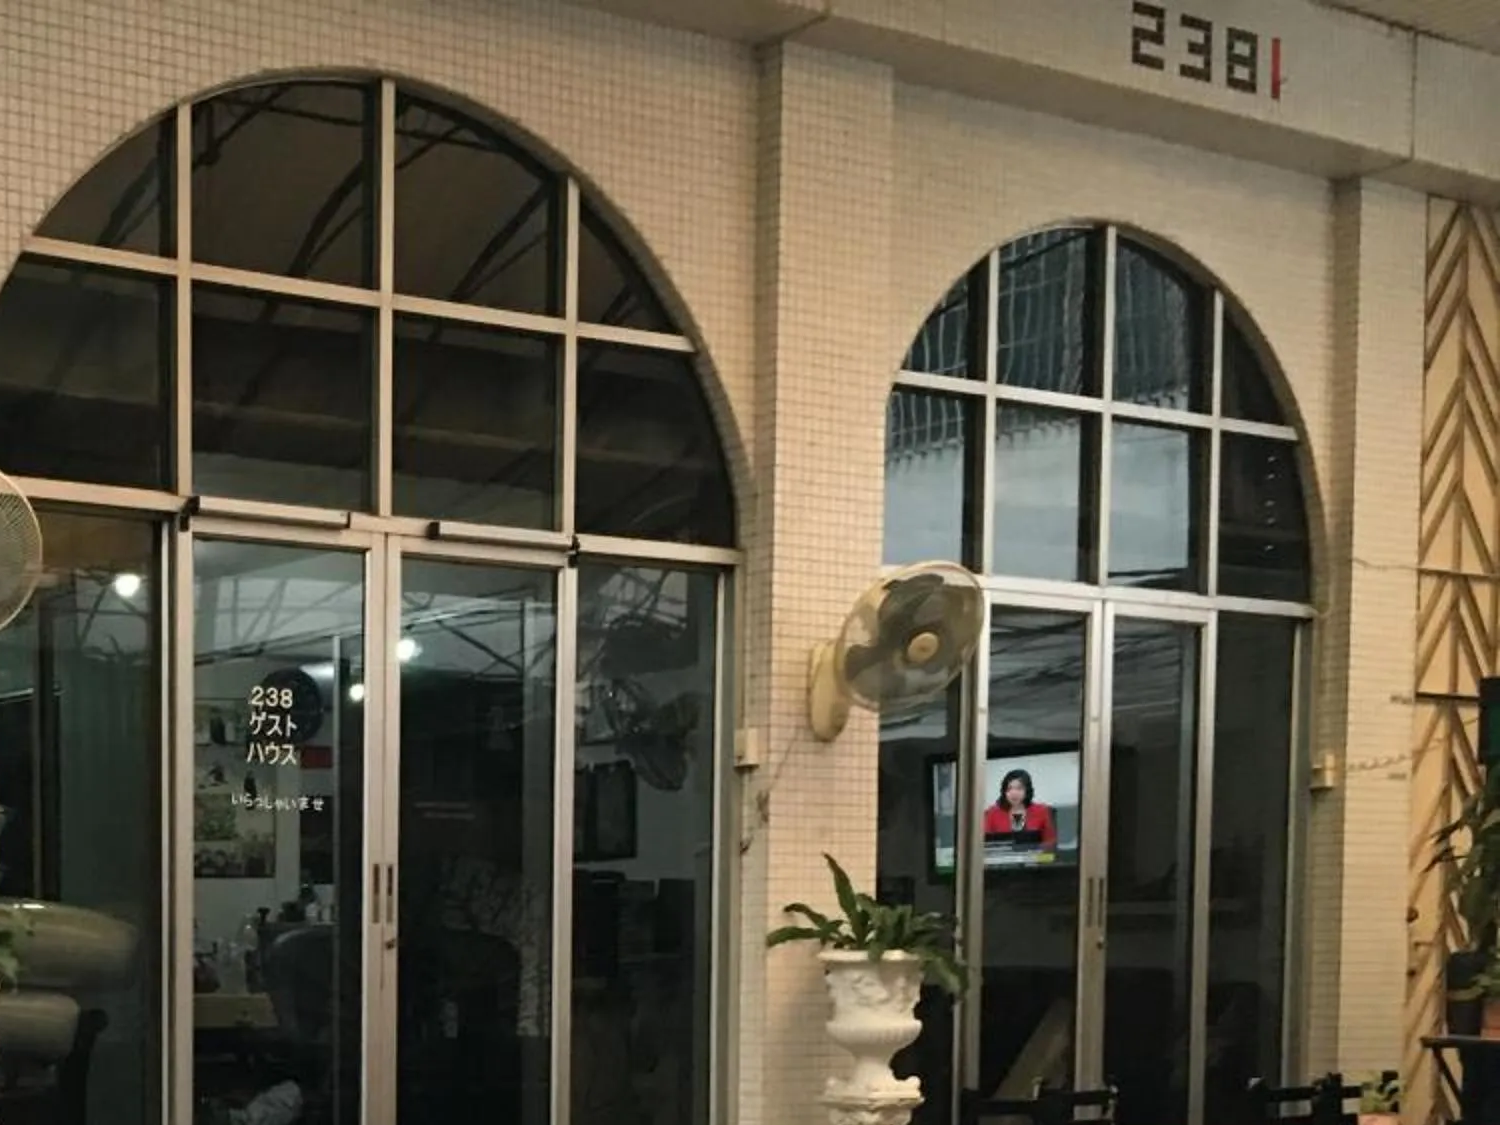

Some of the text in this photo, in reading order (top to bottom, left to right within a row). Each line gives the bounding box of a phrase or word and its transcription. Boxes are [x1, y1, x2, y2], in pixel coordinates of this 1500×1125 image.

[250, 685, 293, 708] 238
[249, 711, 298, 737] ゲスト
[246, 742, 297, 765] ハウス
